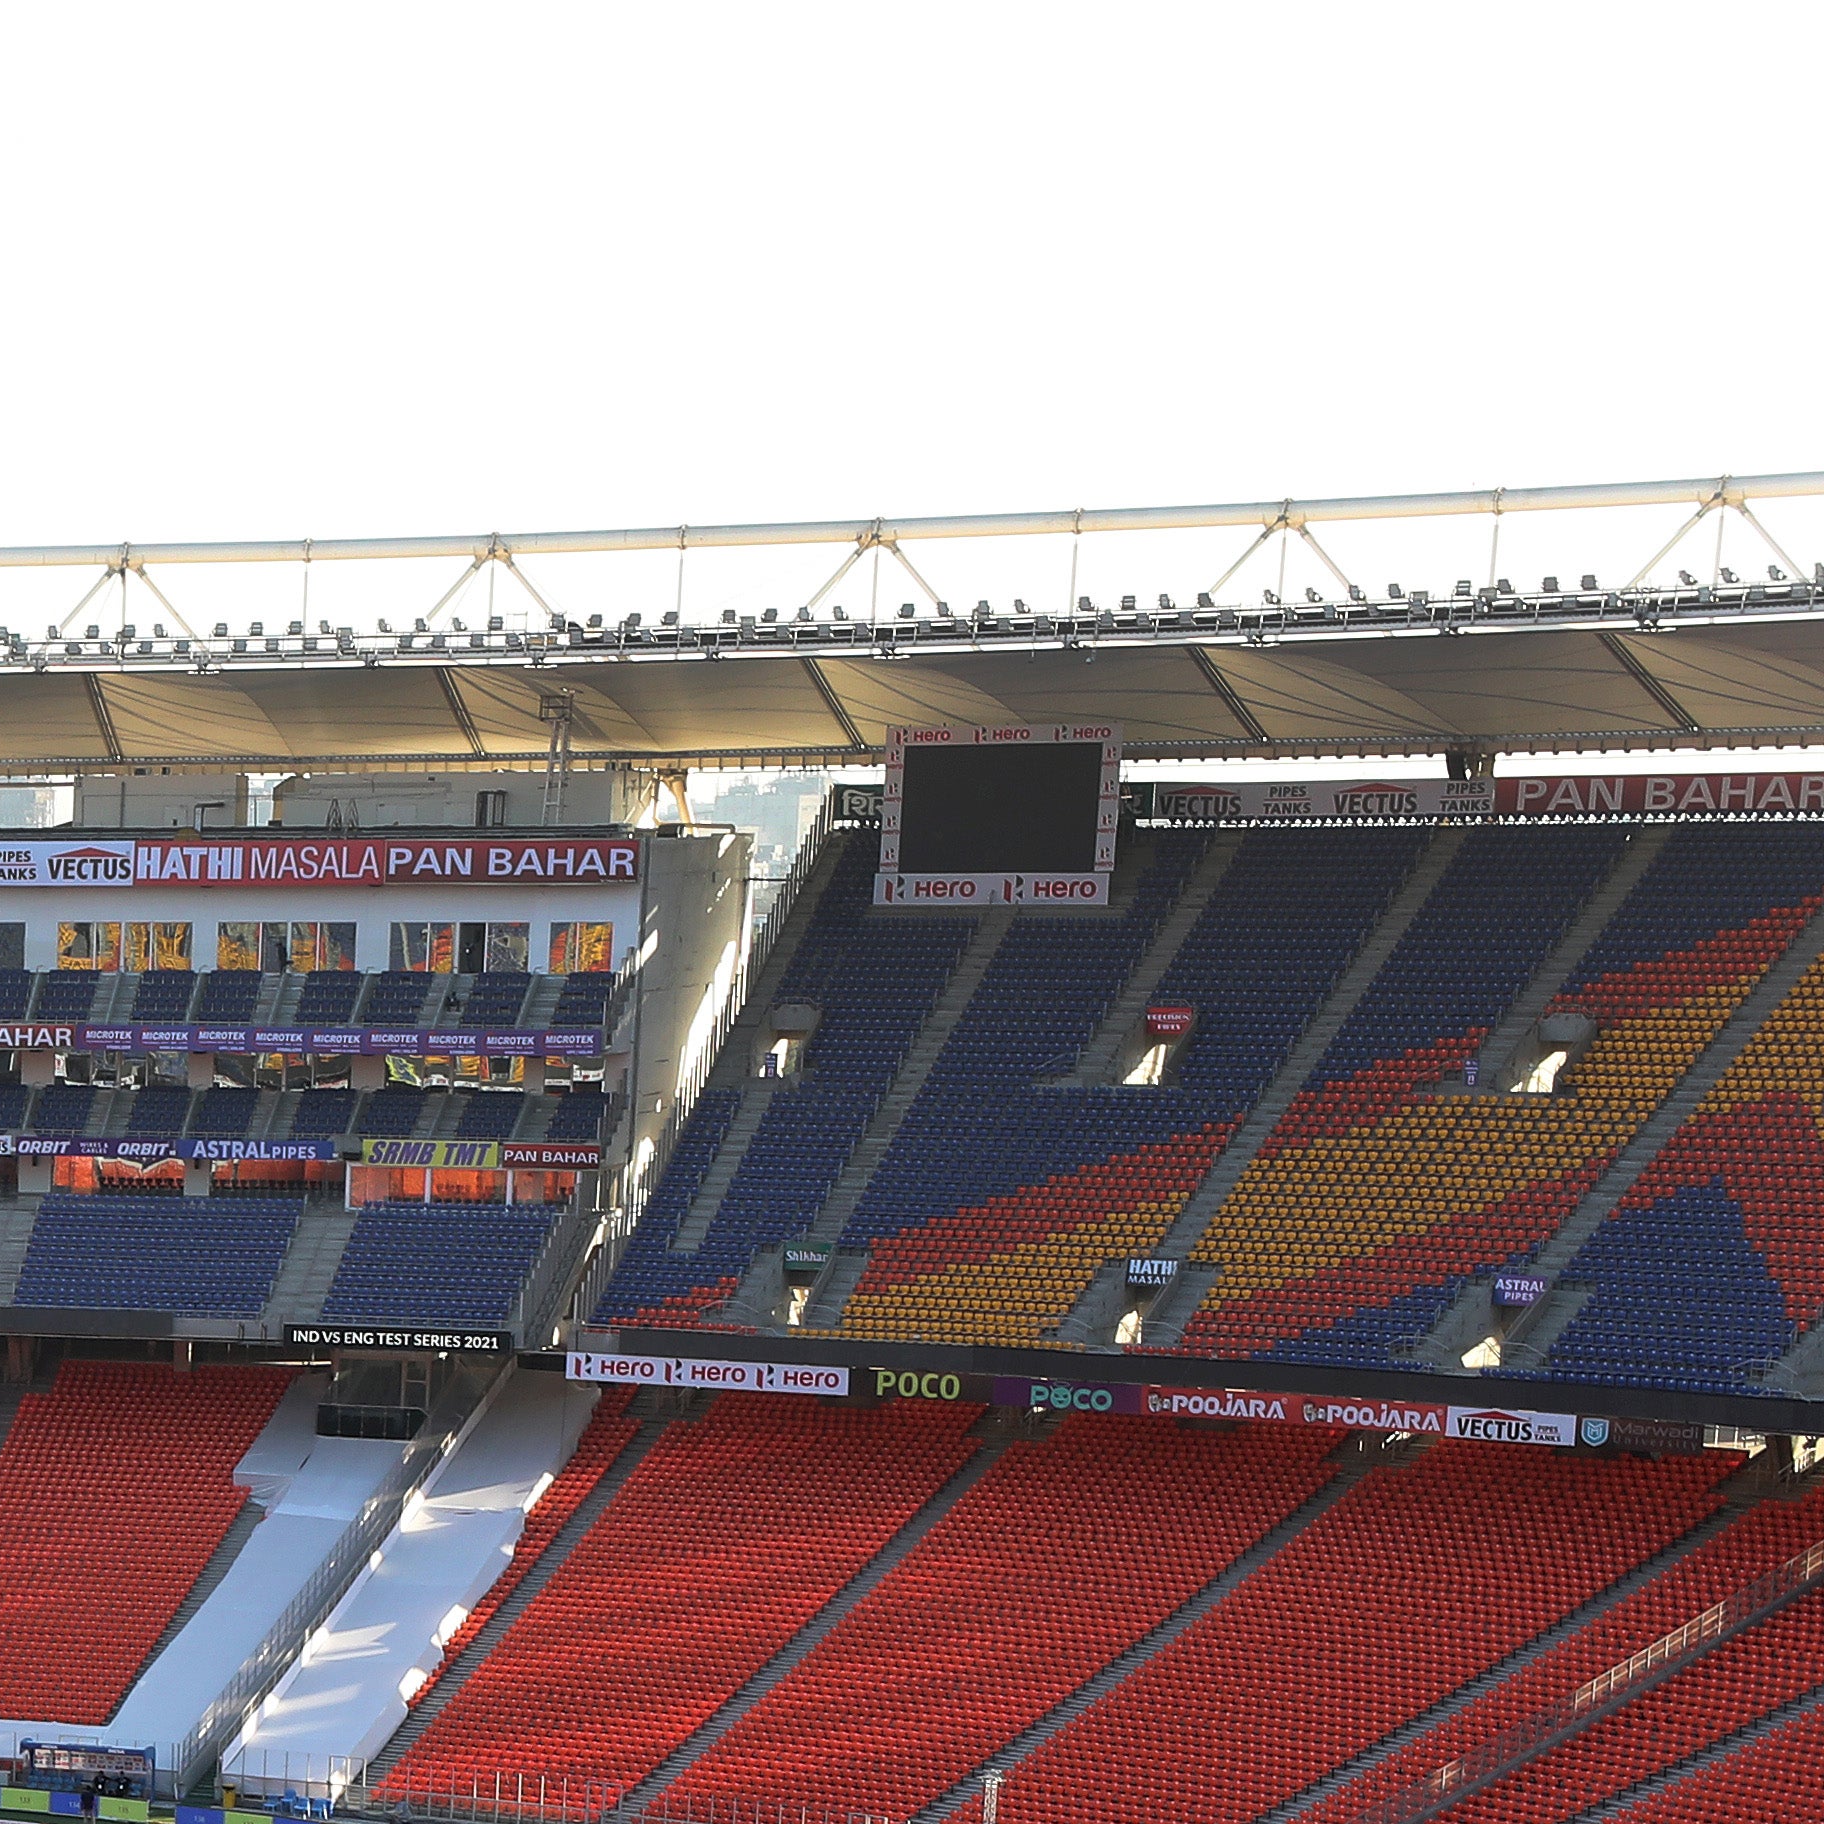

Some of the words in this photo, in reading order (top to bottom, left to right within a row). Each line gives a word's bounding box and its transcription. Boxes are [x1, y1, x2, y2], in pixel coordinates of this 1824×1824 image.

[1269, 785, 1307, 797] PIPES
[1446, 782, 1485, 794] PIPES
[1517, 777, 1624, 811] PAN
[1158, 796, 1241, 816] VECTUS
[1263, 802, 1312, 815] TANKS
[1333, 793, 1417, 814] VECTUS
[1440, 800, 1490, 812] TANKS
[47, 858, 132, 881] VECTUS
[138, 847, 243, 880] HATHI
[250, 847, 380, 880] MASALA
[389, 848, 472, 877] PAN
[487, 848, 635, 877] BAHAR
[85, 1030, 132, 1040] MICROTEK
[255, 1032, 303, 1042] MICROTEK
[545, 1034, 594, 1044] MICROTEK
[18, 1141, 69, 1154] ORBIT
[368, 1140, 439, 1167] SRMB
[443, 1141, 492, 1167] TMT
[503, 1149, 538, 1163] PAN
[541, 1150, 599, 1165] BAHAR
[785, 1249, 828, 1262] Shikhar
[1127, 1275, 1167, 1284] MASAL
[1504, 1291, 1534, 1301] PIPES
[292, 1329, 319, 1343] IND
[322, 1329, 343, 1343] VS
[345, 1330, 374, 1345] ENG
[376, 1332, 413, 1346] TEST
[415, 1333, 461, 1348] SERIES
[464, 1334, 499, 1349] 2021
[875, 1370, 961, 1399] POCO
[1172, 1393, 1286, 1420] POOJARA
[1326, 1404, 1441, 1431] POOJARA
[1457, 1418, 1533, 1441] VECTUS
[1614, 1422, 1698, 1439] Marwadi
